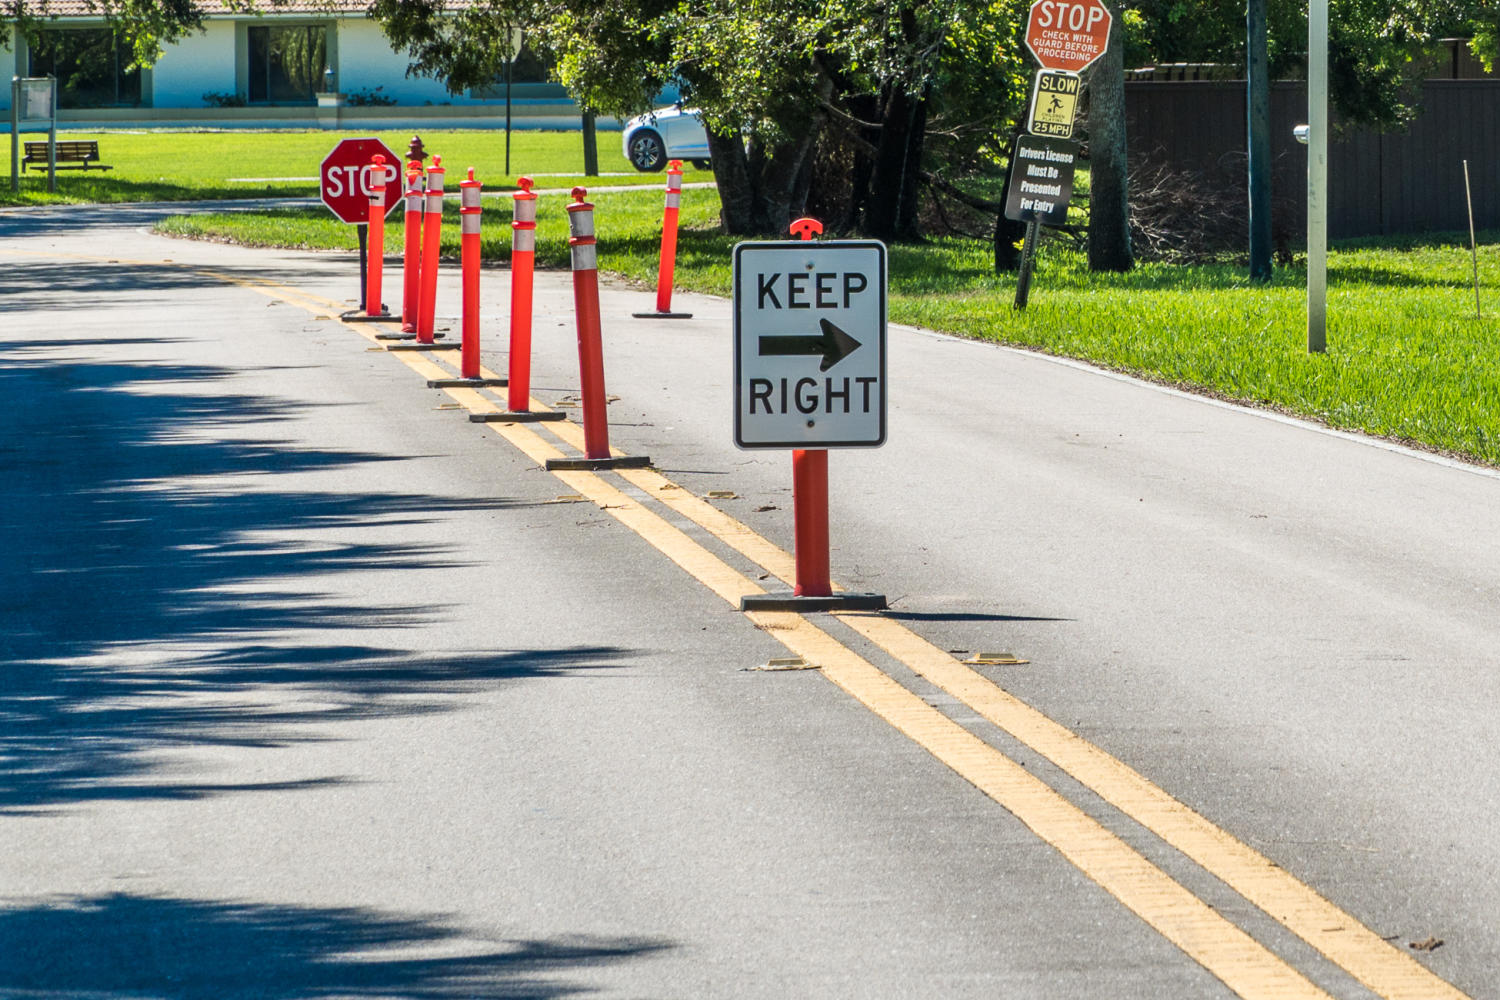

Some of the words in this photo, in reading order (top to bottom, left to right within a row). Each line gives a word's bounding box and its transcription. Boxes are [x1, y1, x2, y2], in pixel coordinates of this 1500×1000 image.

[1038, 0, 1104, 32] STOP
[1041, 30, 1070, 41] CHECK
[1072, 33, 1094, 44] WITH
[1033, 38, 1063, 49] GUARD
[1064, 42, 1099, 54] BEFORE
[1037, 47, 1091, 61] PROCEEDING
[1041, 76, 1077, 93] SLOW
[1034, 122, 1048, 133] 25
[1048, 124, 1070, 136] MPH
[1019, 147, 1045, 160] Drivers
[1046, 150, 1073, 163] License
[1027, 164, 1047, 178] Must
[1047, 166, 1059, 179] Be
[1020, 181, 1061, 196] Presented
[1020, 197, 1033, 210] For
[1033, 199, 1054, 213] Entry
[757, 272, 868, 309] KEEP
[749, 377, 878, 414] RIGHT
